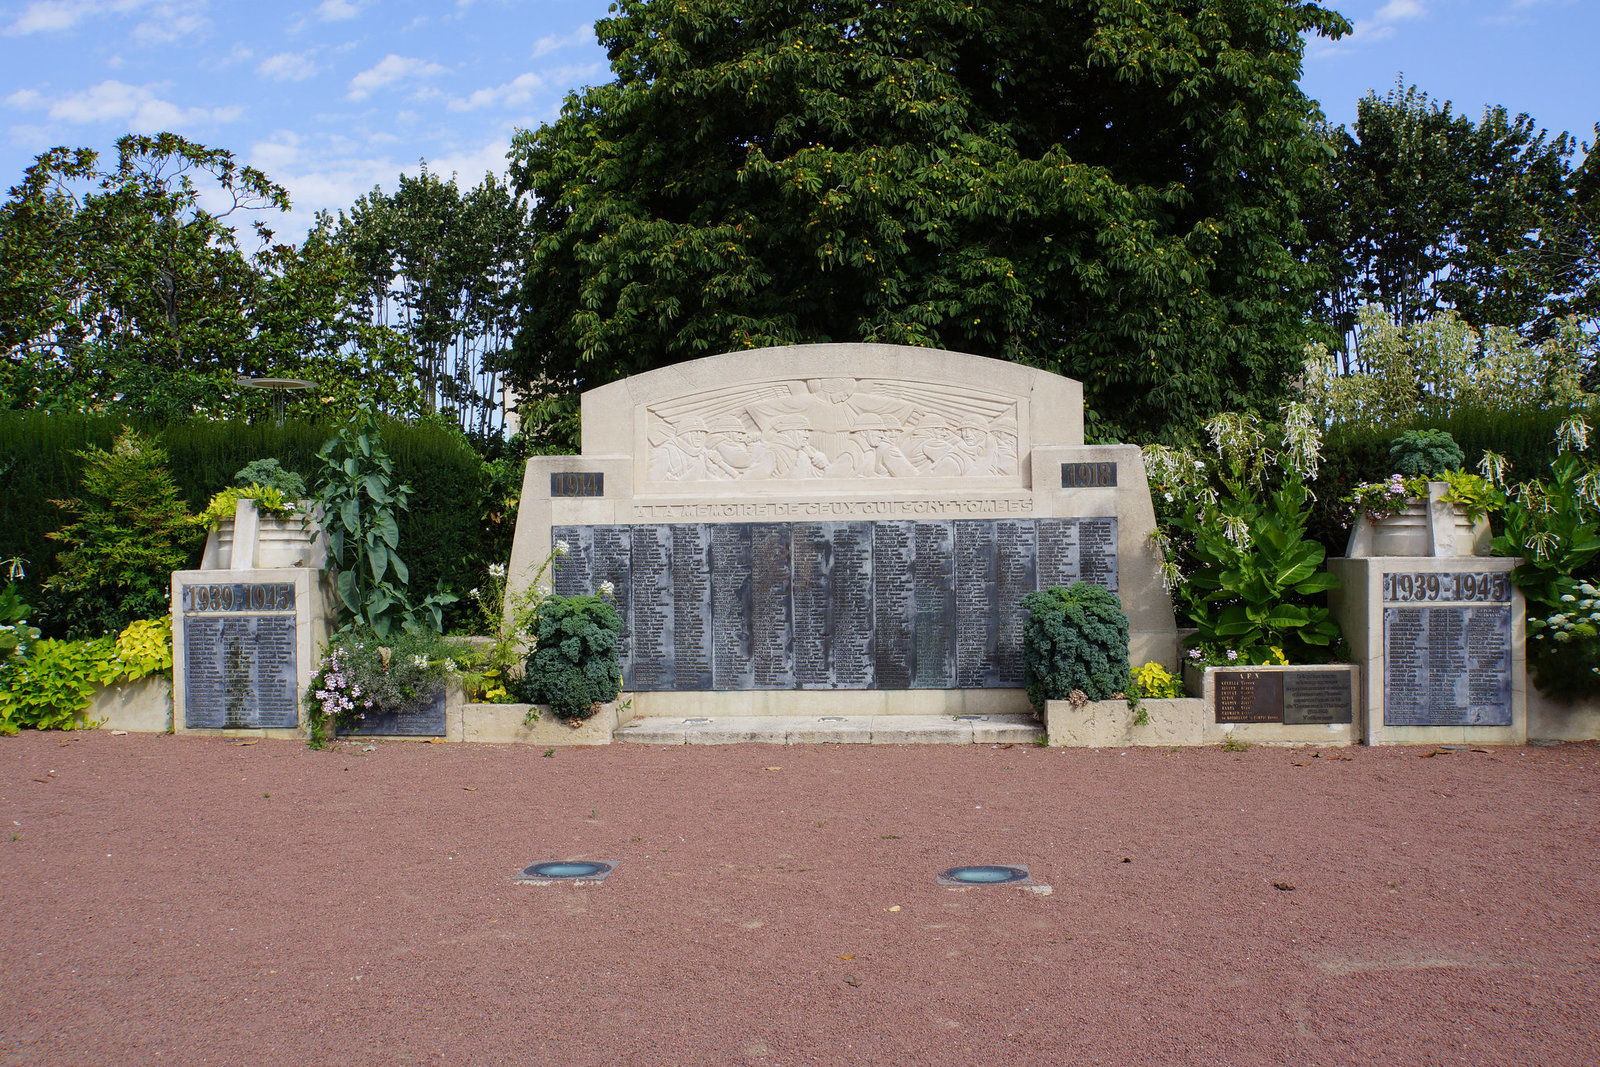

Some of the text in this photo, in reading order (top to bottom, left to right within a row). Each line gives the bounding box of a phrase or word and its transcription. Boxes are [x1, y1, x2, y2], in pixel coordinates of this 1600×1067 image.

[556, 474, 598, 497] 1914
[1067, 463, 1111, 487] 1918
[634, 500, 1033, 518] A LA MEMOIRE DE CEUX QUI SONT TOMBES
